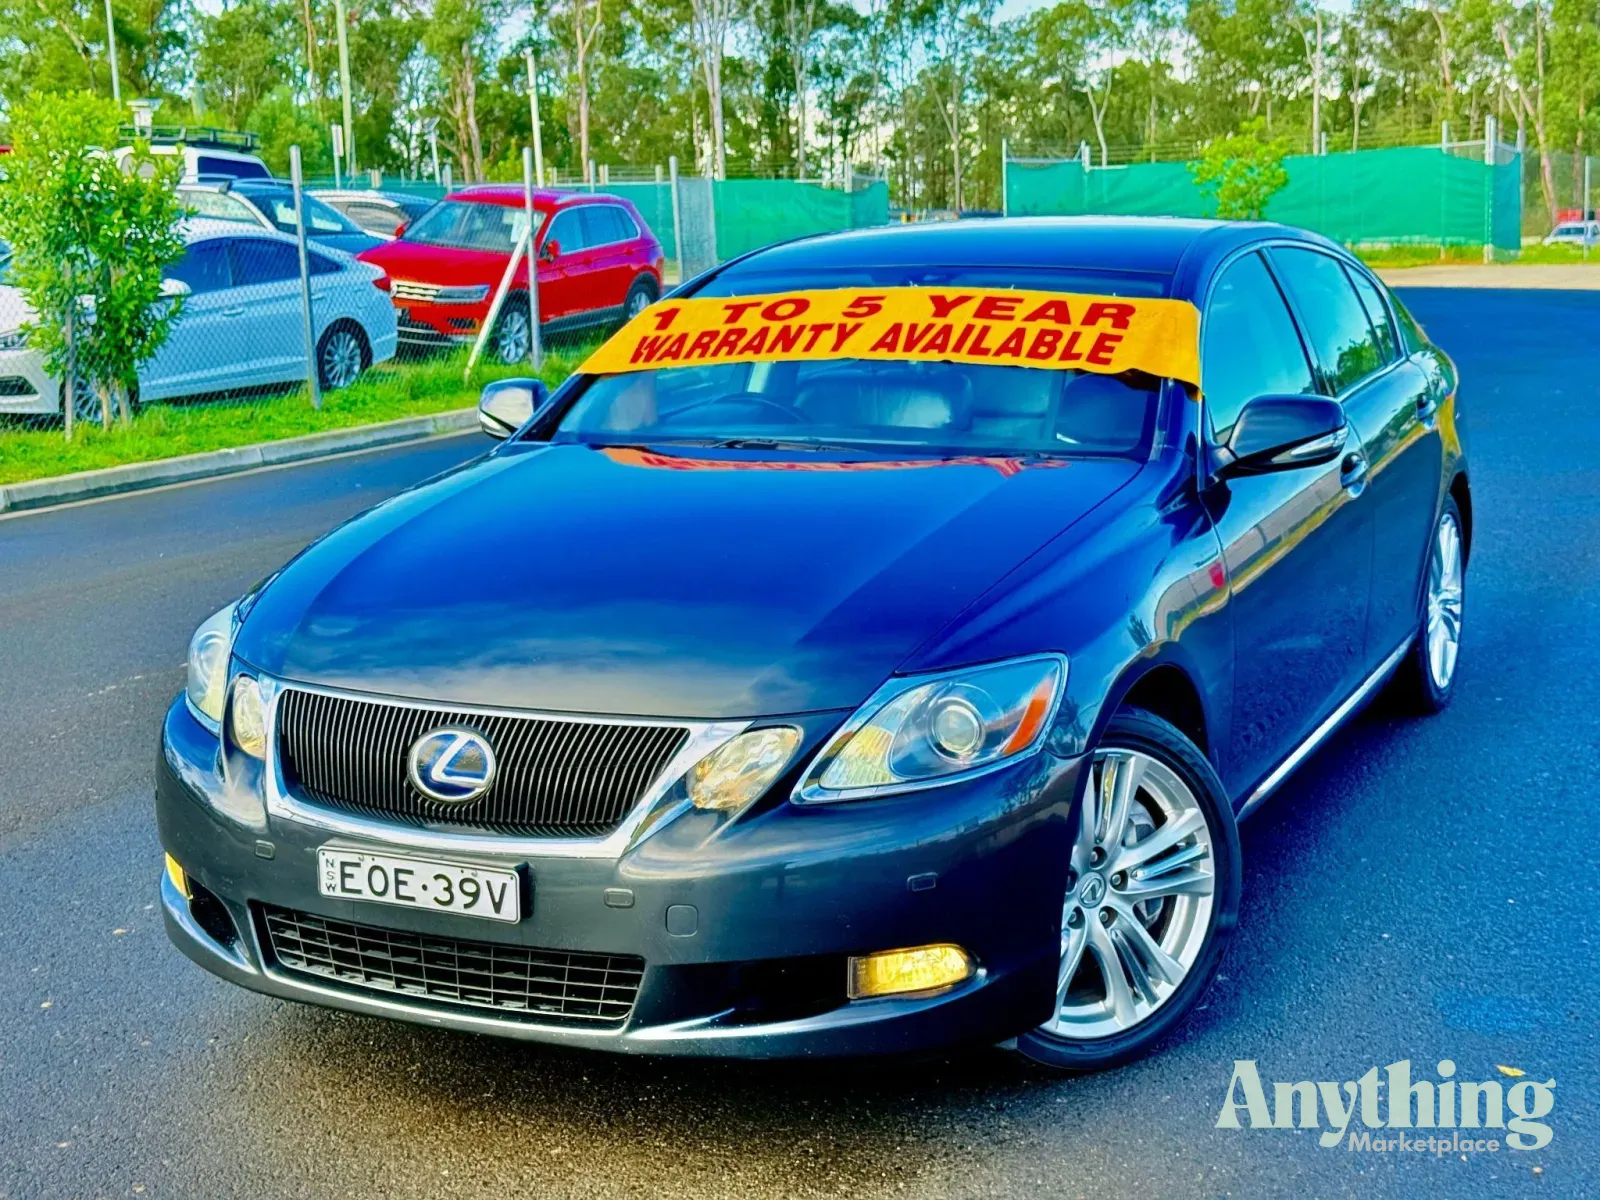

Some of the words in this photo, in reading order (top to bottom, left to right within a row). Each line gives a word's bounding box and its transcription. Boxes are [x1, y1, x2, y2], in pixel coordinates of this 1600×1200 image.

[655, 307, 681, 331] 1
[723, 298, 811, 325] TO
[841, 296, 887, 318] 5
[927, 295, 1136, 330] YEAR
[629, 323, 862, 364] WARRANTY
[869, 322, 1124, 366] AVAILABLE
